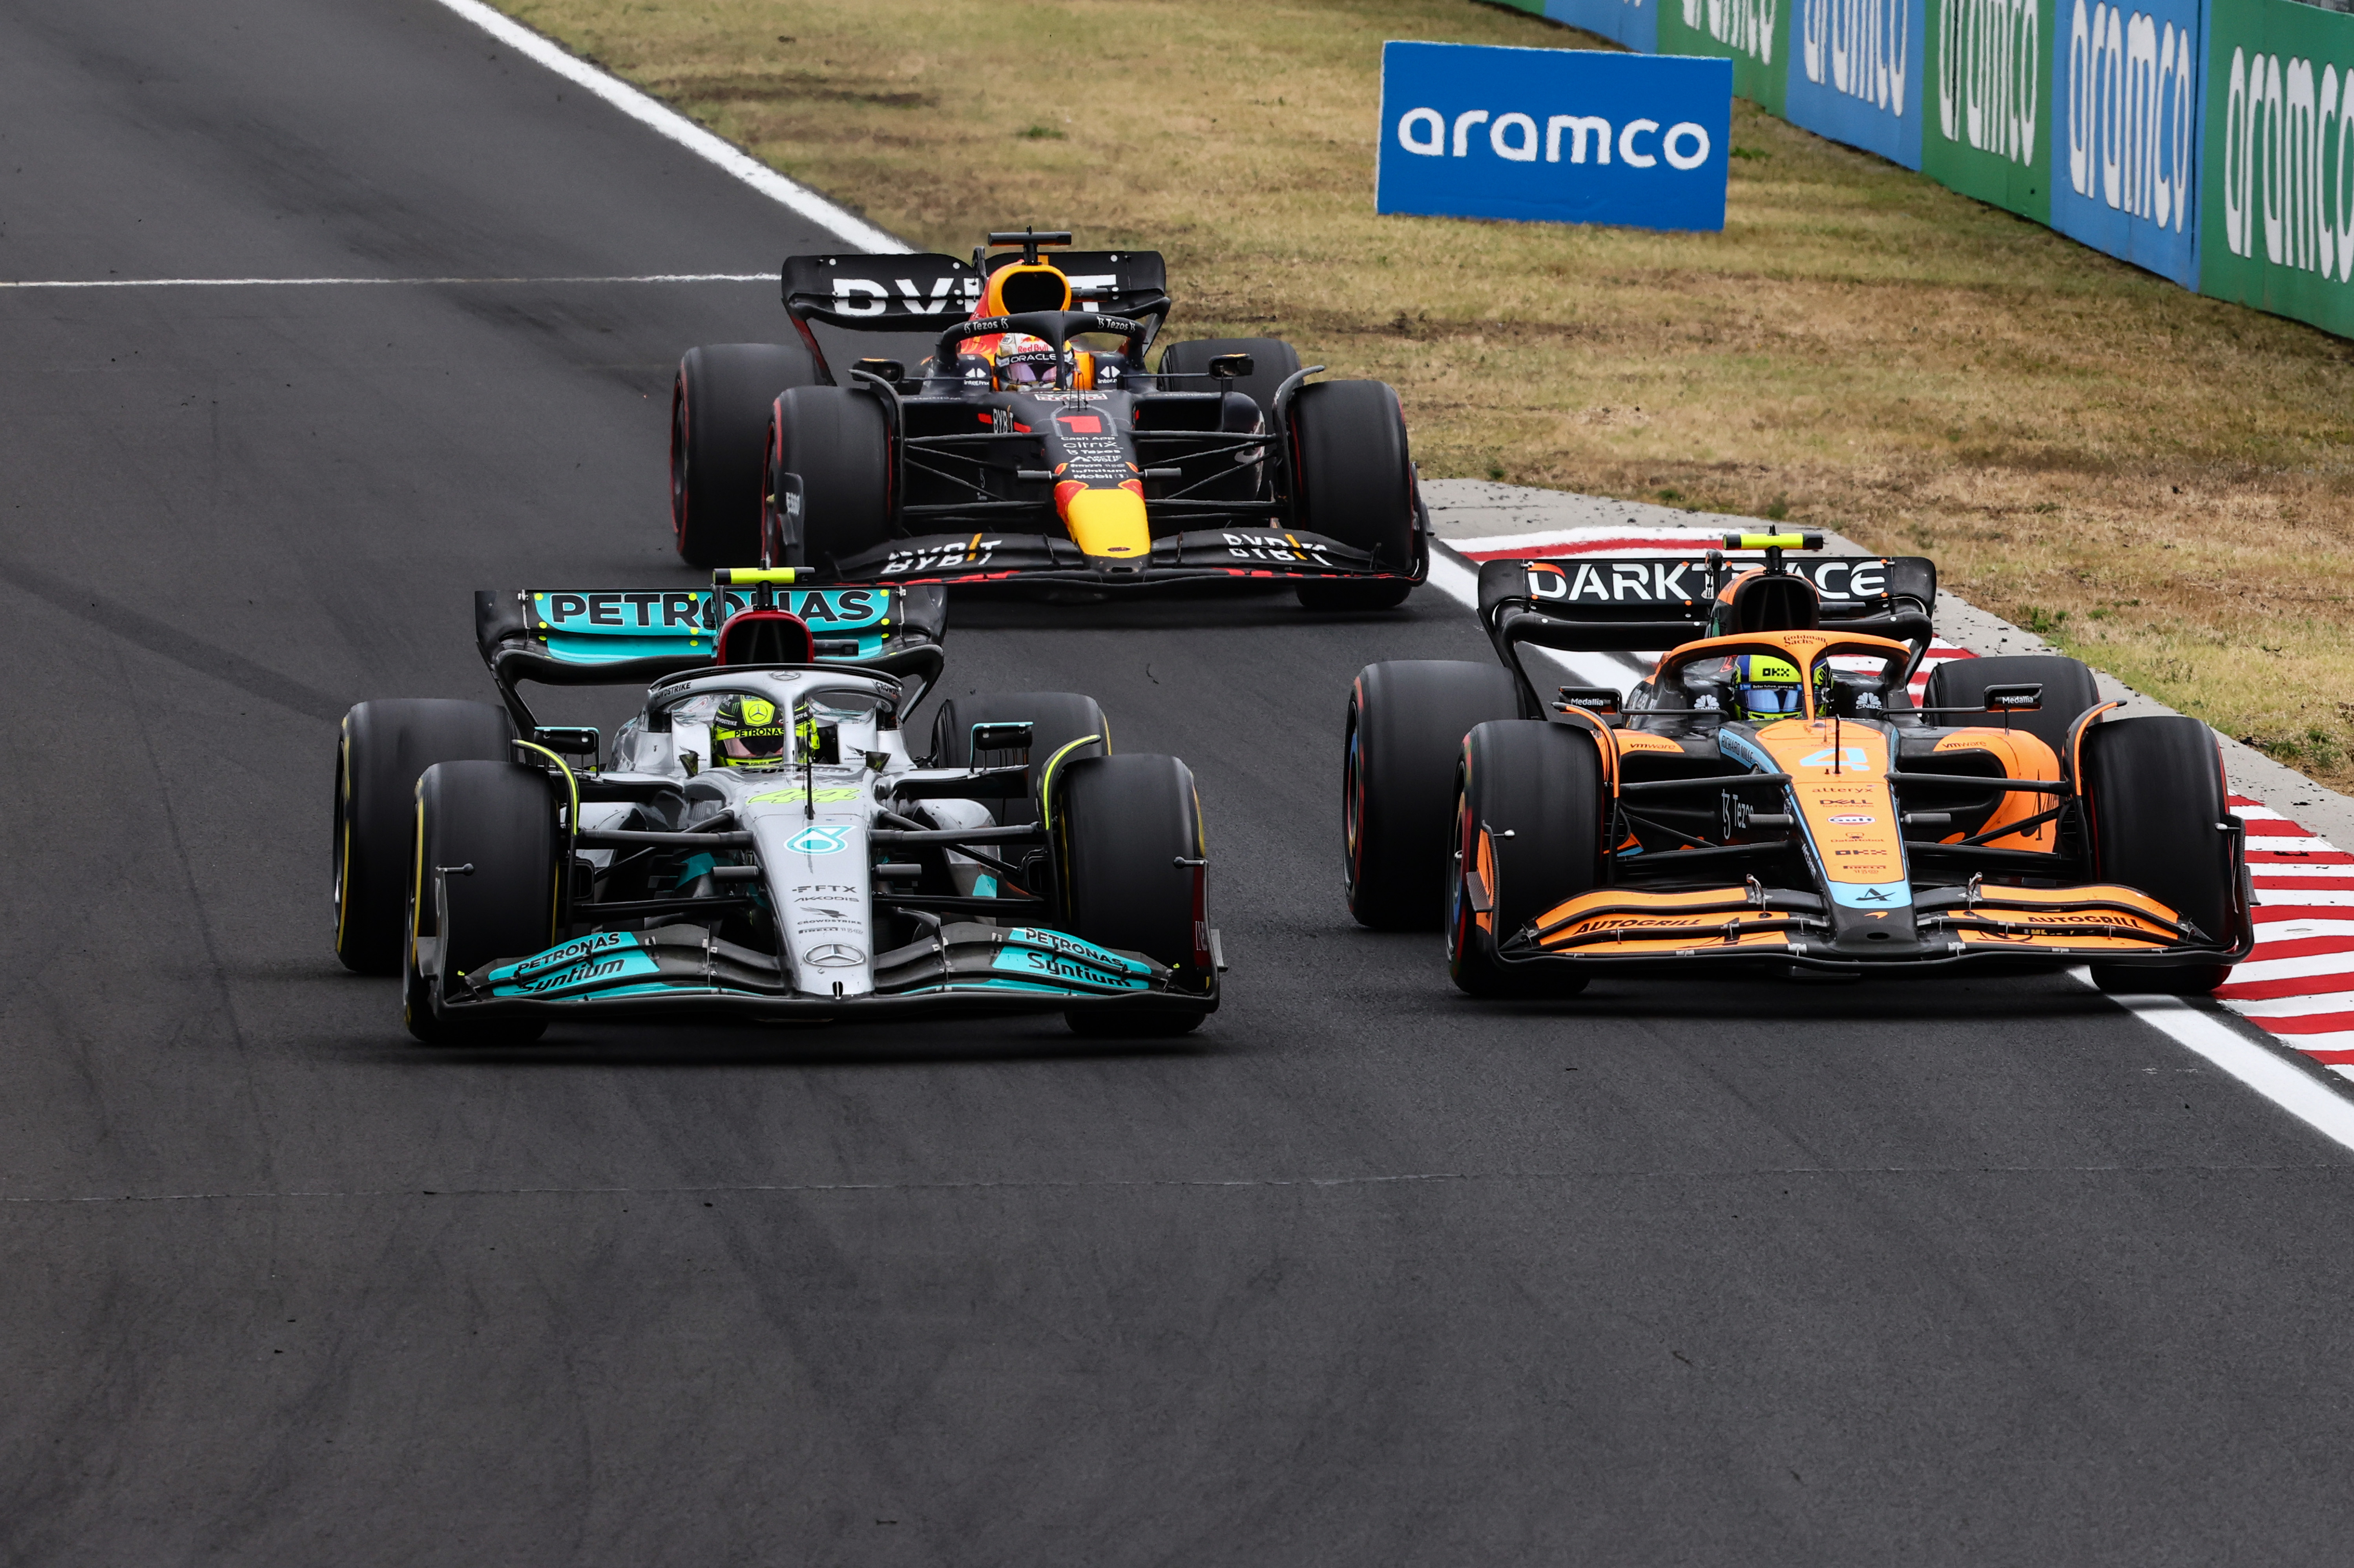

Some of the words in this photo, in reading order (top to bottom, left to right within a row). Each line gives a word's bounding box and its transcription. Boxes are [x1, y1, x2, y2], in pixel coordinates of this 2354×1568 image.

[2069, 0, 2190, 235] aramco
[1398, 106, 1710, 170] aramco
[2225, 46, 2354, 284] aramco
[973, 321, 998, 330] Tezos
[1106, 319, 1128, 330] Tezos
[1018, 344, 1032, 353] Red
[1011, 354, 1057, 363] ORACLE
[1056, 416, 1102, 432] 1
[1785, 639, 1814, 647] Sachs
[1763, 668, 1789, 676] OKX
[2002, 695, 2034, 704] Medallia
[735, 728, 784, 737] PETRONAS
[1799, 748, 1870, 771] 4
[746, 788, 862, 805] 44
[1572, 919, 1702, 935] AUTOGRILL
[2027, 915, 2144, 930] AUTOGRILL
[518, 933, 620, 972] PETRONAS
[1025, 928, 1126, 967] PETRONAS
[514, 959, 625, 993] Syntium
[1027, 952, 1132, 987] Syntium
